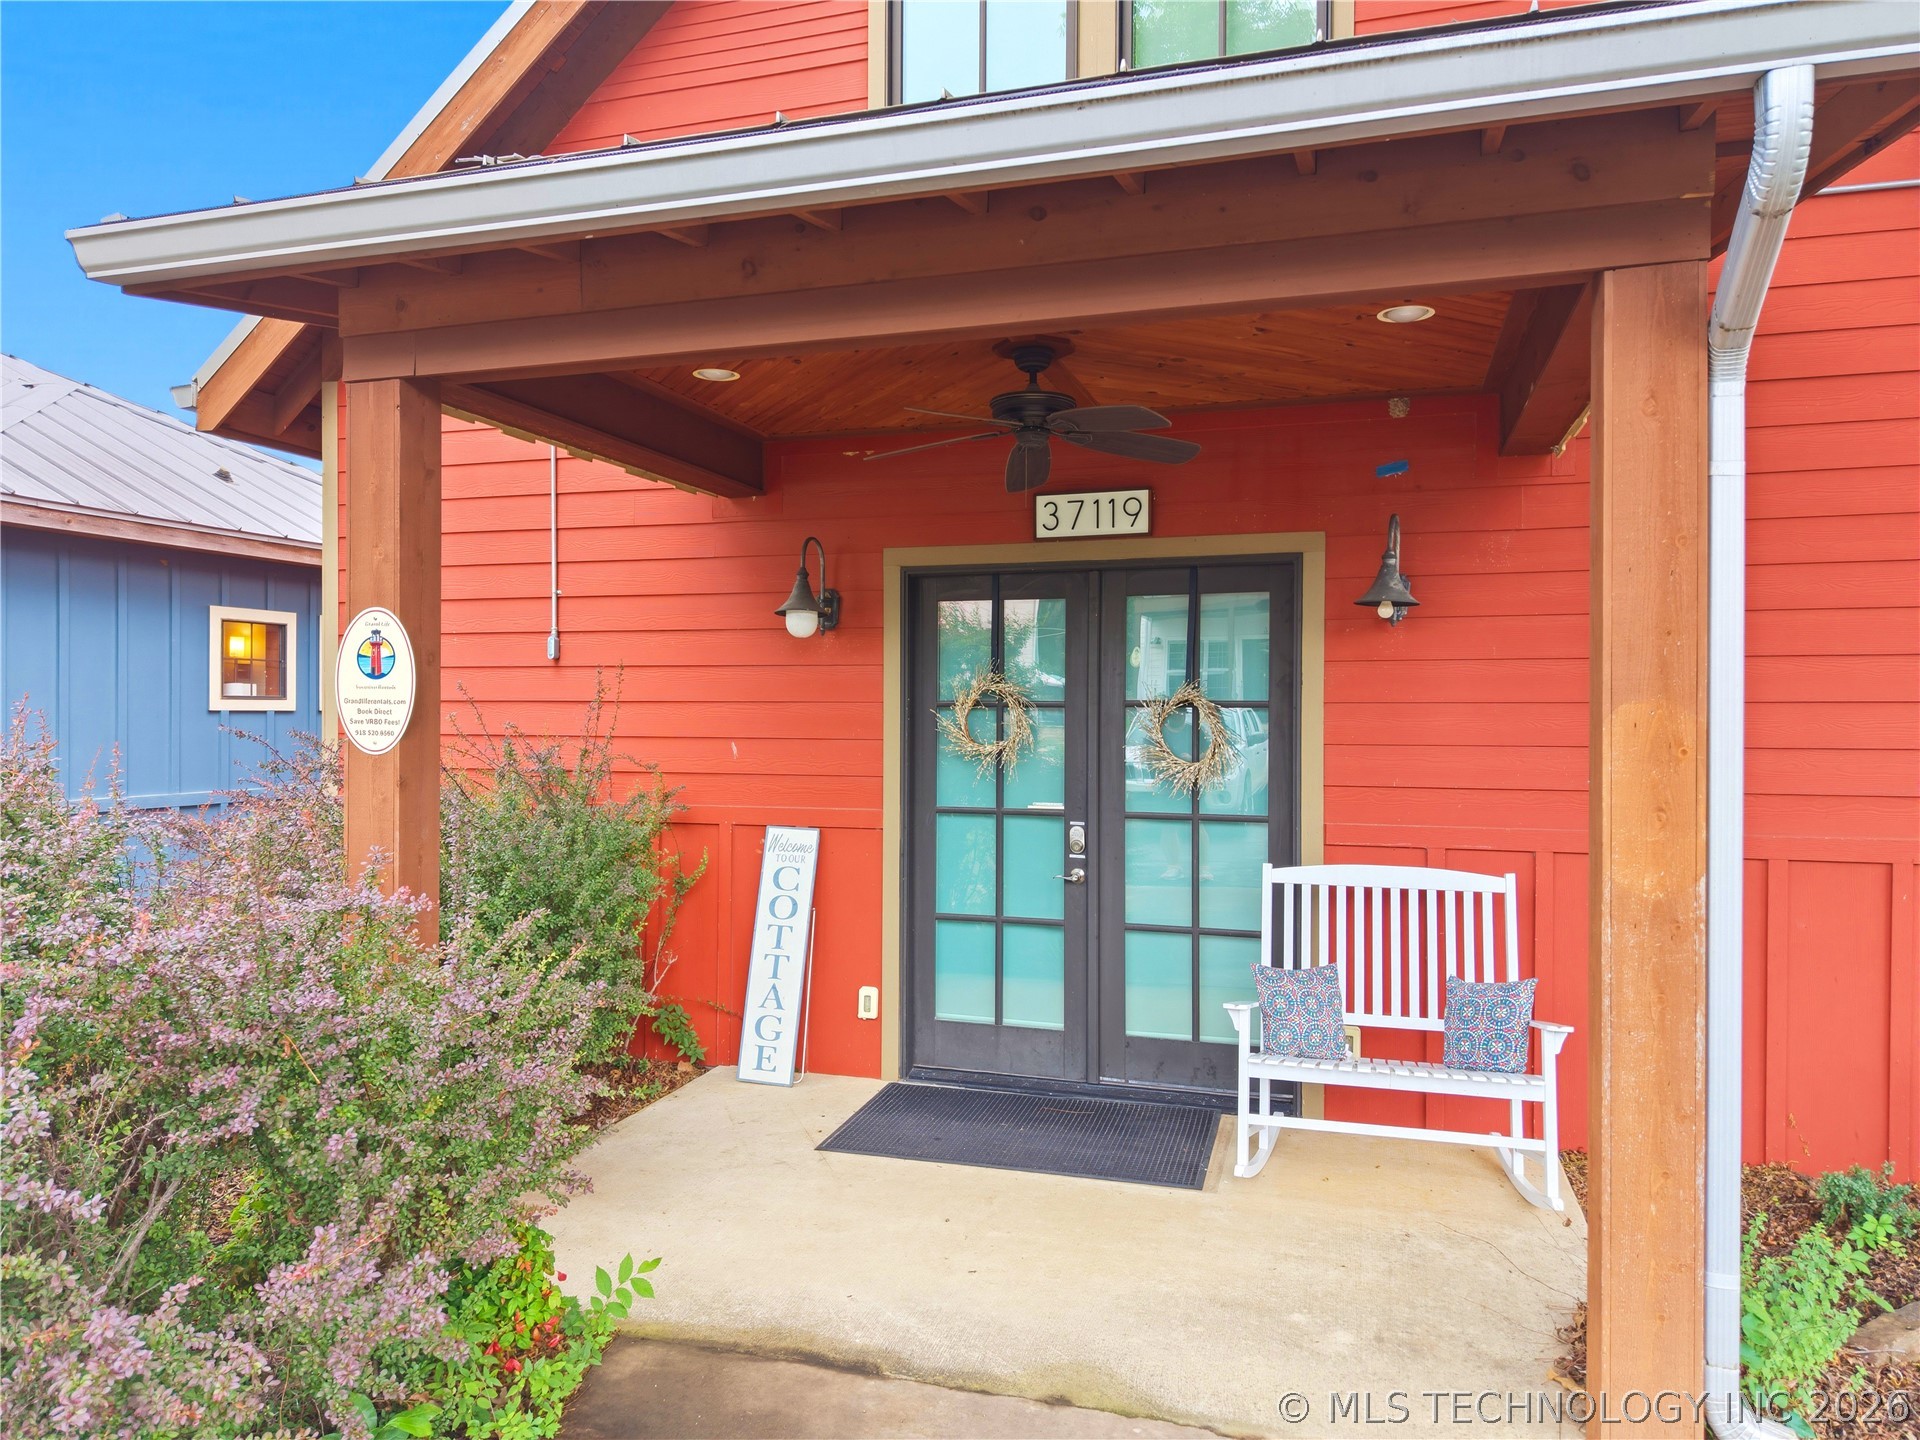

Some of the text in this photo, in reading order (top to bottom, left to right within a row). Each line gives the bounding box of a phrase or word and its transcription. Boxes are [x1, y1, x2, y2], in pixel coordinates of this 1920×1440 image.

[1042, 496, 1142, 532] 37119
[768, 833, 815, 854] Welcome
[776, 853, 806, 864] TO OUR
[752, 866, 801, 1073] COTTAGE
